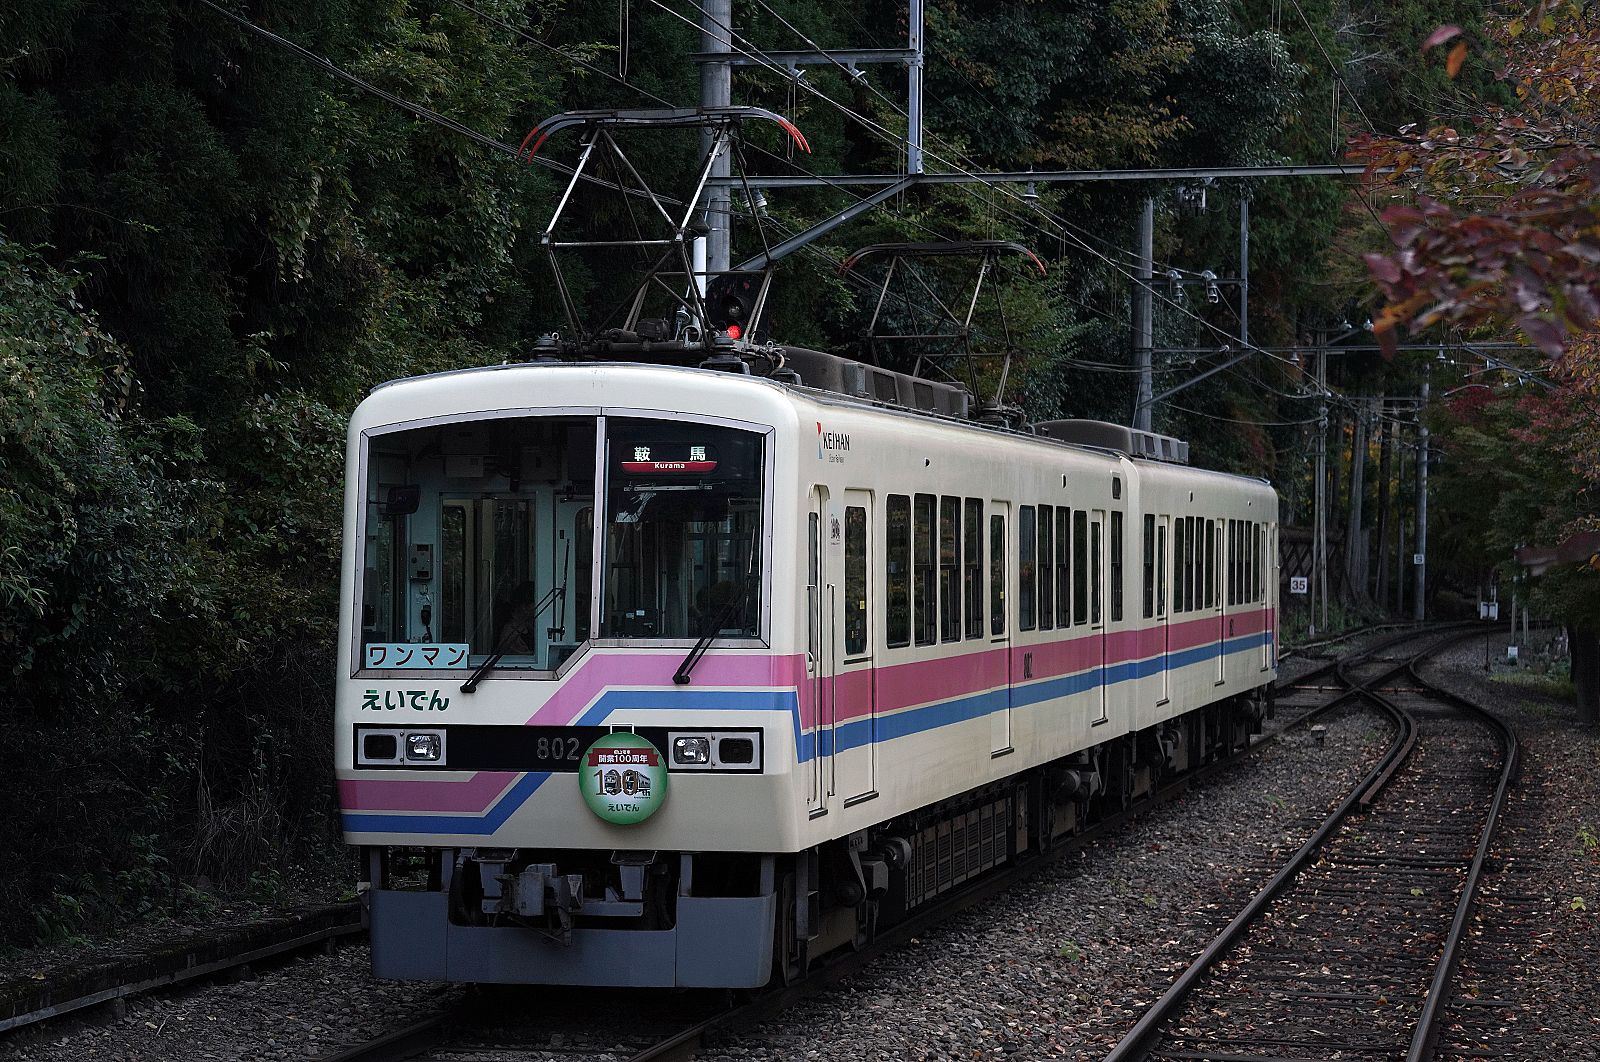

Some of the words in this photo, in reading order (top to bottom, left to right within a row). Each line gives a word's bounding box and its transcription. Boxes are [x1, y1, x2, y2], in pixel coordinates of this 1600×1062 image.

[822, 430, 850, 451] KEIHAN
[634, 446, 706, 461] 鞍馬
[1292, 580, 1306, 591] 35
[369, 646, 466, 666] ワンマン
[361, 689, 450, 712] えいでん
[536, 737, 580, 761] 802
[598, 754, 648, 763] 開業100周年
[607, 803, 640, 813] えいでん
